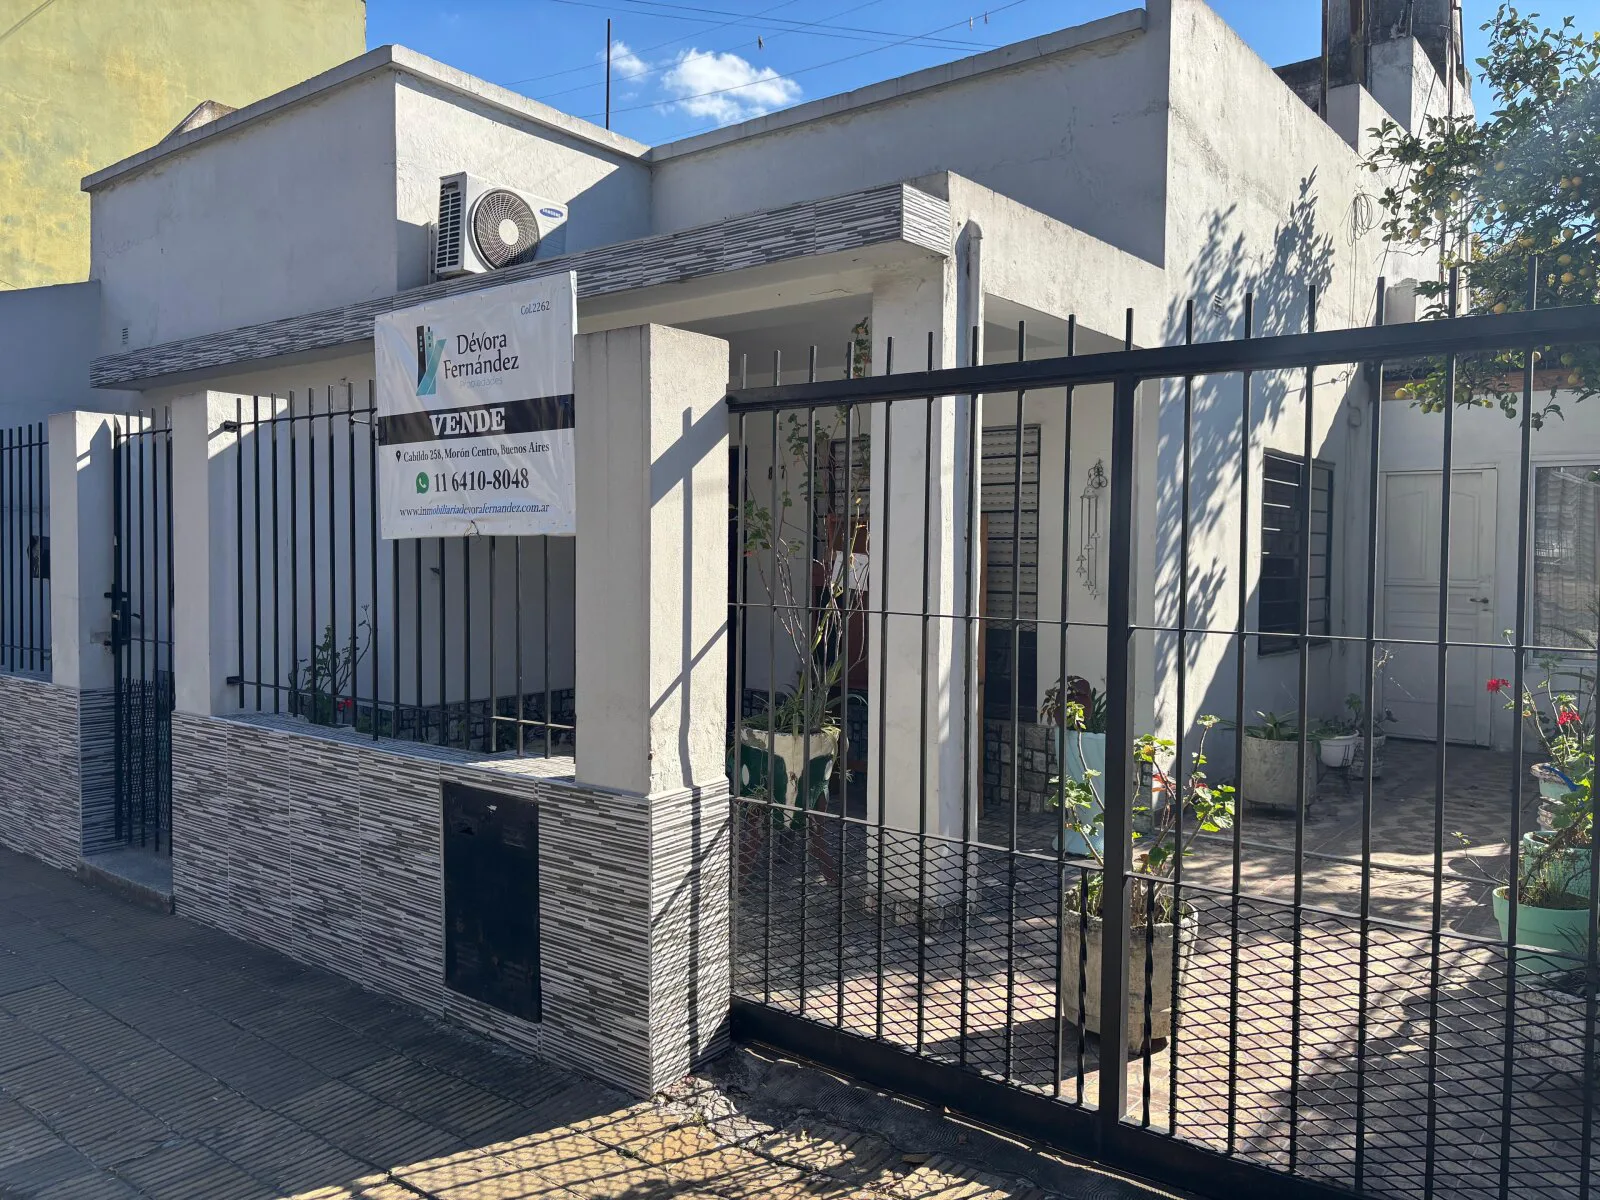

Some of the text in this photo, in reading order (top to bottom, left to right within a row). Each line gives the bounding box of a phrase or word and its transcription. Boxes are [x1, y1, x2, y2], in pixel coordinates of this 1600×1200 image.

[520, 300, 550, 315] Col.2262
[456, 332, 507, 355] Dévora
[443, 349, 519, 379] Fernández
[429, 407, 506, 436] VENDE
[403, 441, 550, 462] Cabildo 258, Morón Centro, Buenos Aires
[434, 468, 529, 492] 11 6410-8048
[400, 502, 550, 517] www.inmobiliariadevorafernandez.com.ar
